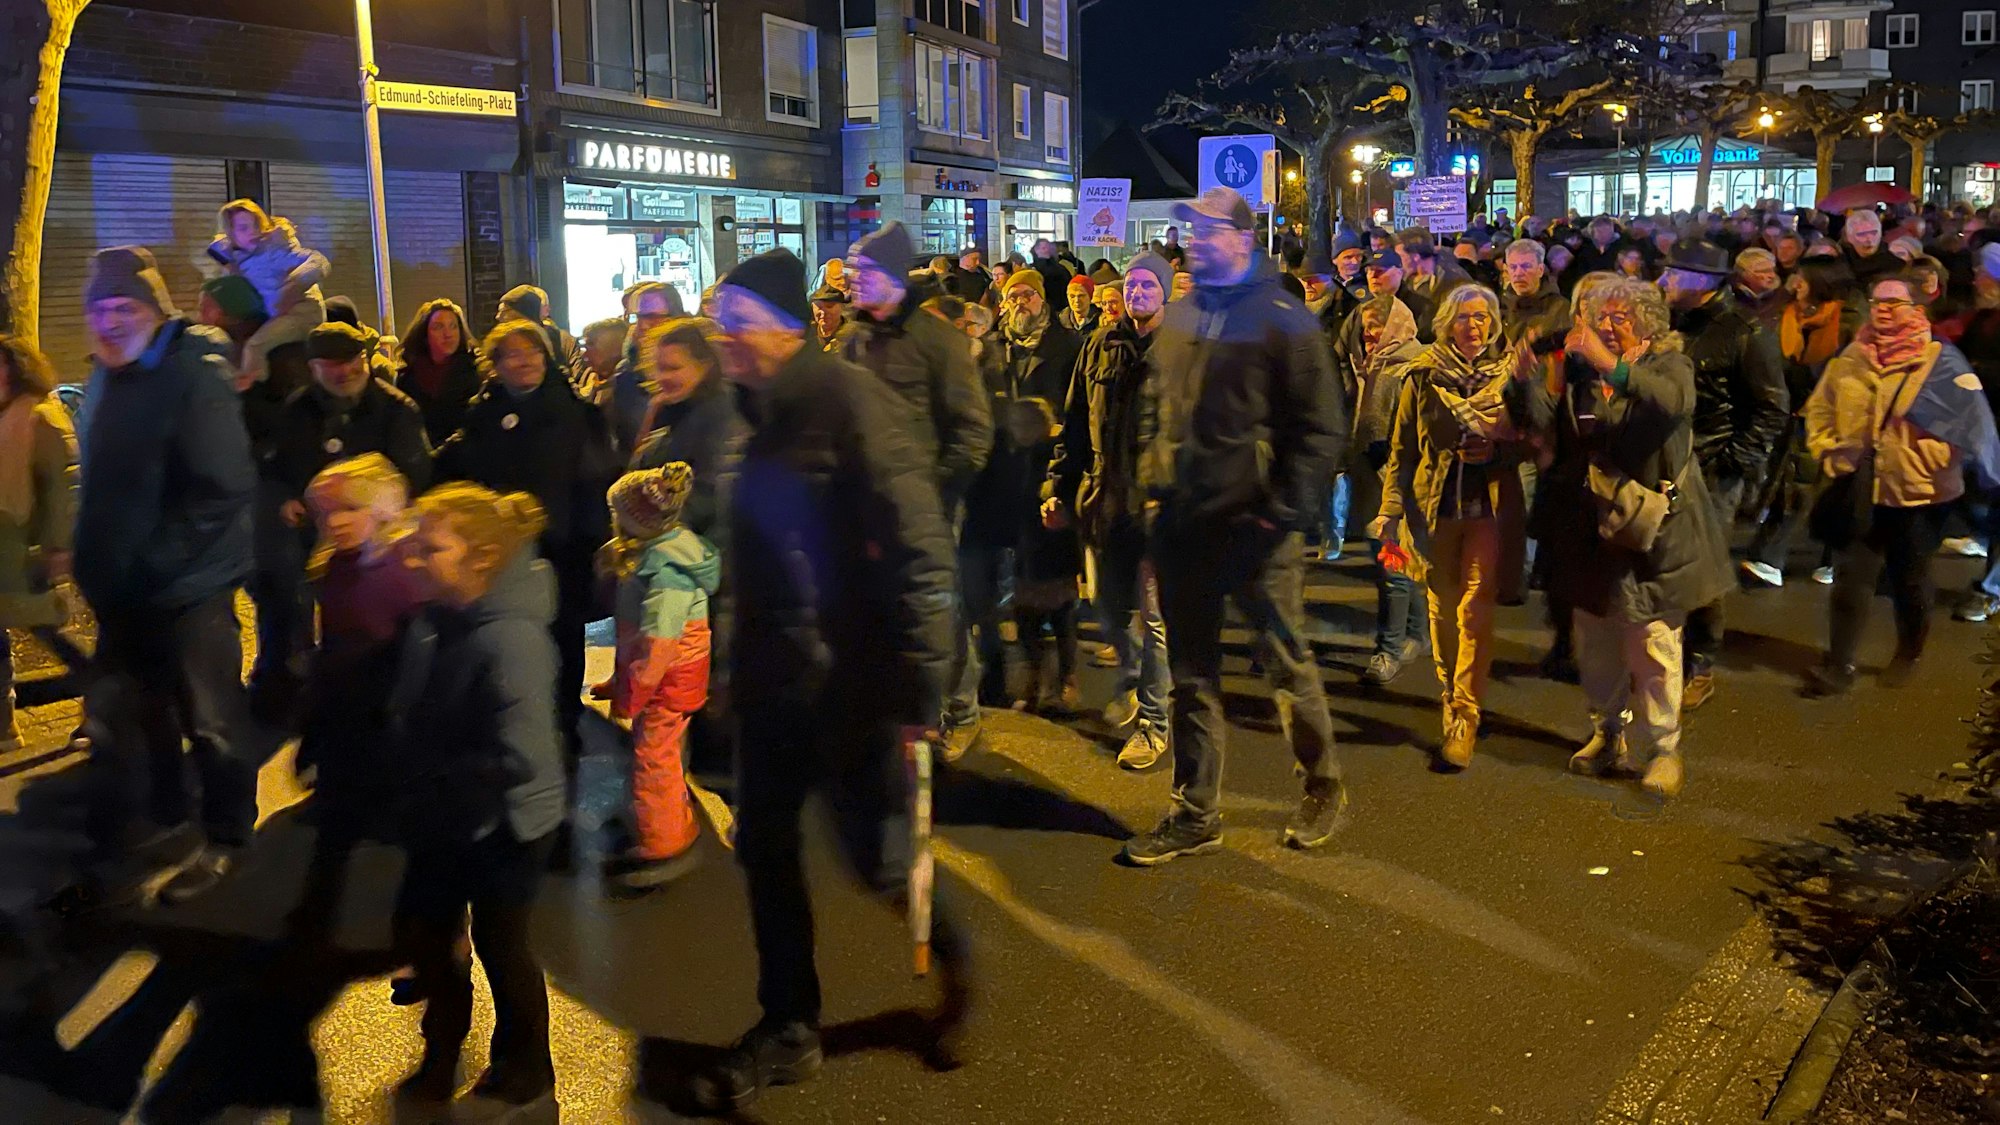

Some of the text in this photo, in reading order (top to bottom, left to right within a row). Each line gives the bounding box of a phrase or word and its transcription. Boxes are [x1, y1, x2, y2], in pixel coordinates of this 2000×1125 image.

[380, 86, 513, 112] Edmund-Schiefeling-Platz
[1661, 146, 1760, 165] Volkbank
[1086, 186, 1123, 197] NAZIS?
